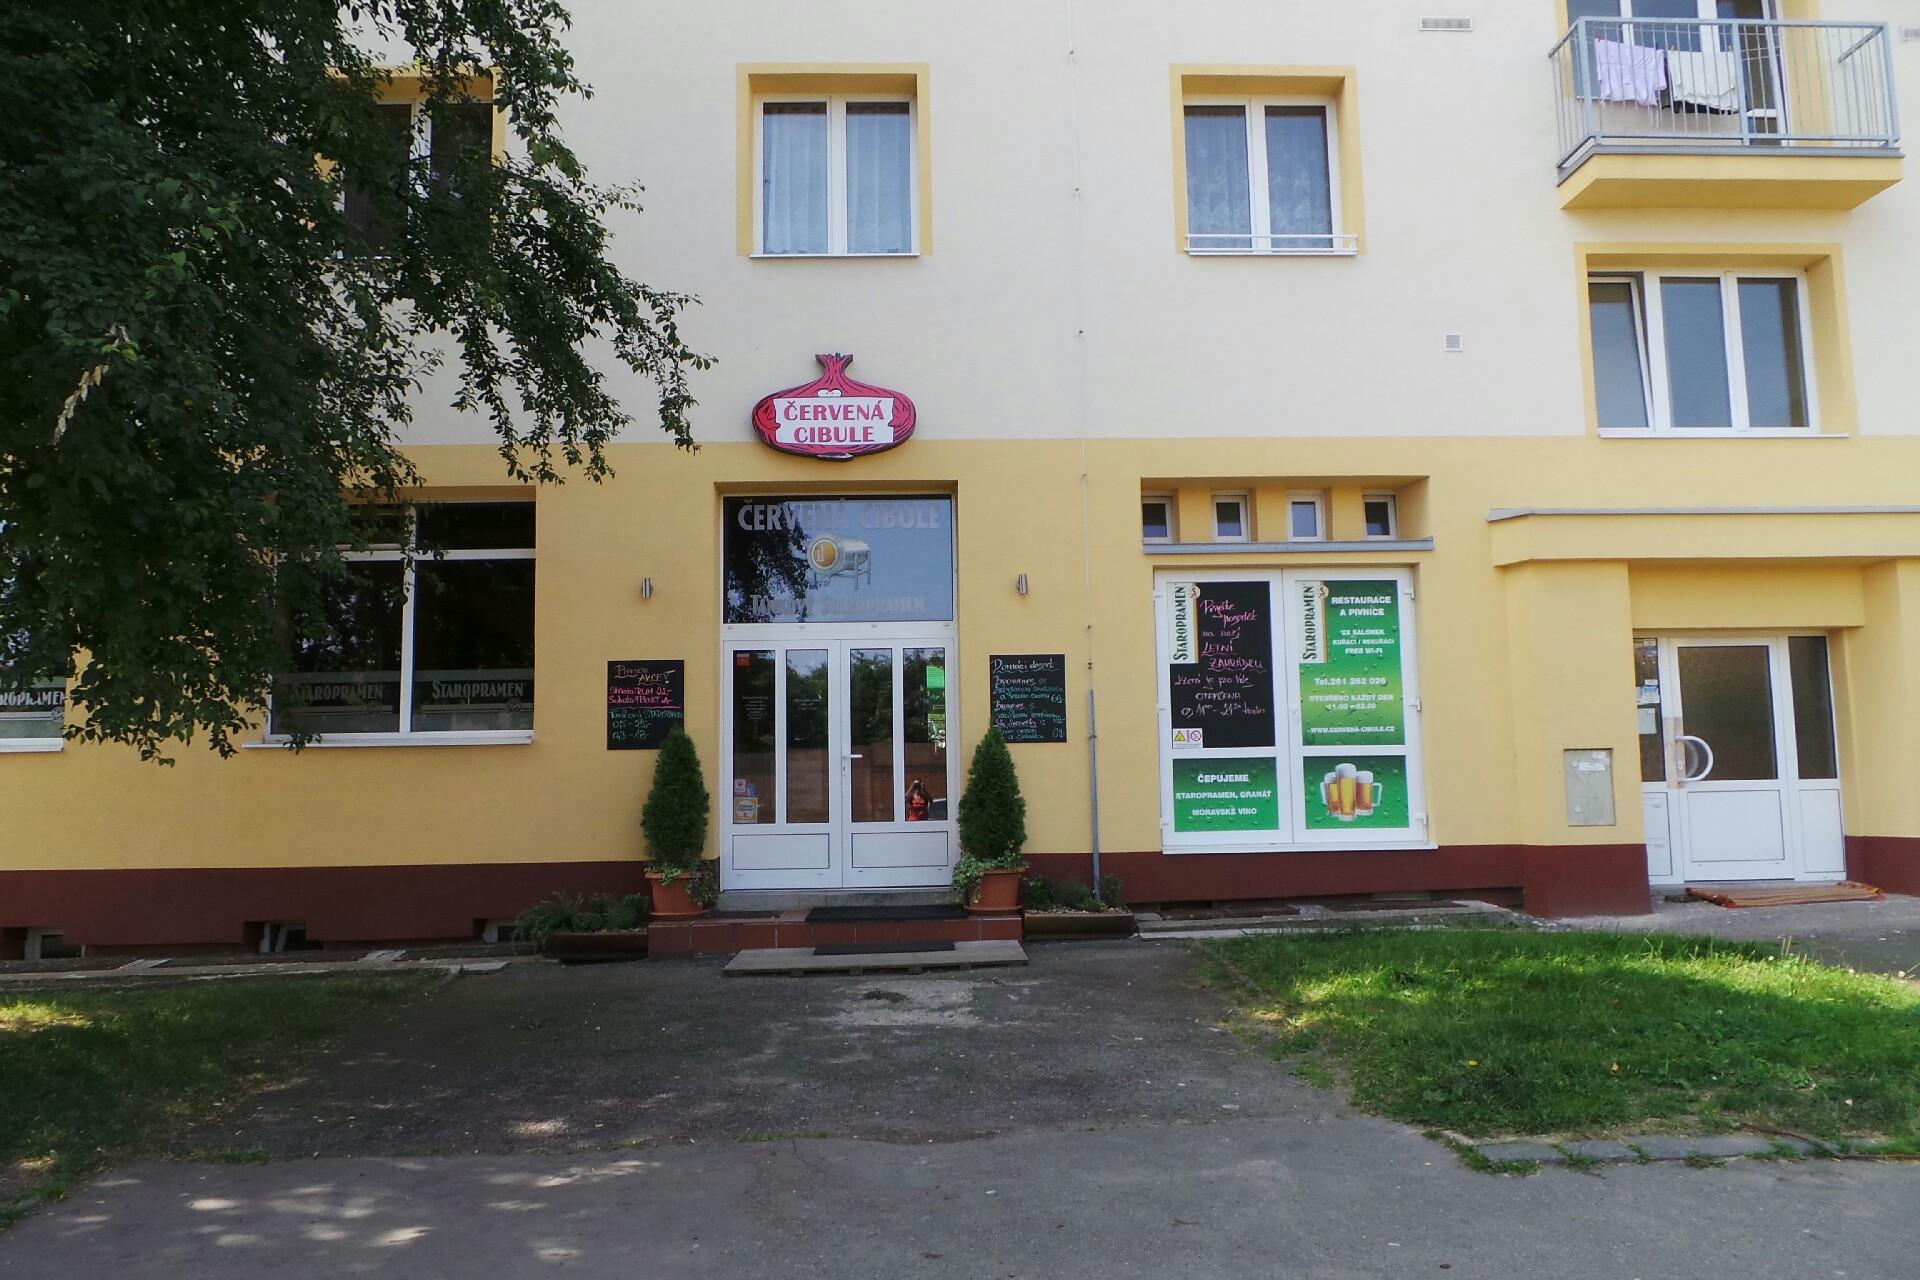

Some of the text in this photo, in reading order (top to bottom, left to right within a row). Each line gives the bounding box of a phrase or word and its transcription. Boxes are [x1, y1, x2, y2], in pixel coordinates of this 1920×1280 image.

[784, 401, 885, 421] ČERVENÁ
[793, 426, 875, 443] CIBULE
[737, 499, 941, 532] ČERVENÁ CIBULE
[1331, 596, 1392, 604] RESTAURACE
[1339, 608, 1384, 616] A PIVNICE
[1174, 586, 1187, 660] STAROPRAMEN
[1302, 585, 1316, 659] STAROPRAMEN
[431, 680, 524, 699] STAROPRAMEN
[1197, 773, 1249, 783] ČEPUJEME
[1175, 790, 1271, 800] STAROPRAMEN, GRANÁT
[1192, 806, 1257, 816] MORAVSKÉ VÍNO
